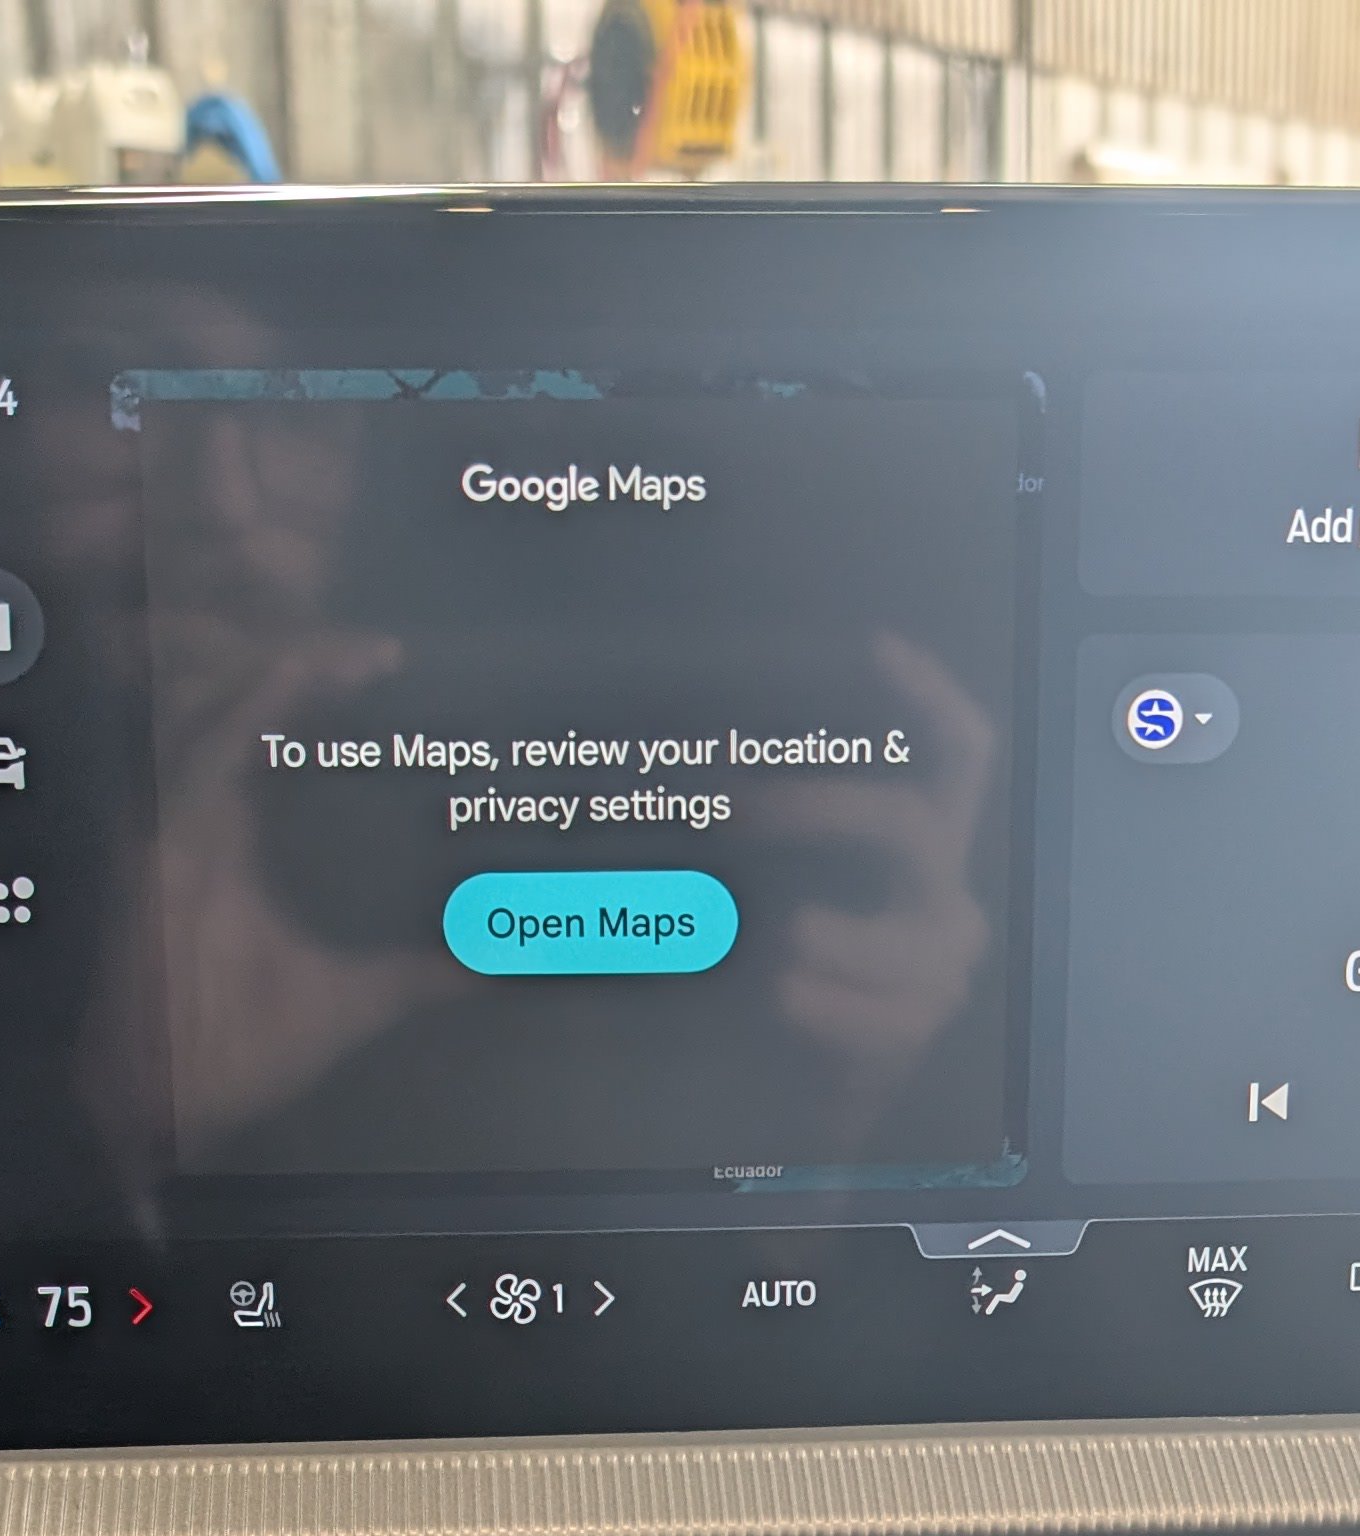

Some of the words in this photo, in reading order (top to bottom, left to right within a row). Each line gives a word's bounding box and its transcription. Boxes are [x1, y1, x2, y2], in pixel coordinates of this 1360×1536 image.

[461, 463, 600, 512] Google
[608, 464, 707, 511] Maps
[1286, 507, 1354, 544] Add
[260, 733, 307, 768] To
[317, 740, 382, 768] use
[393, 733, 499, 776] Maps,
[512, 729, 630, 767] review
[638, 738, 720, 774] your
[730, 728, 872, 765] location
[883, 729, 910, 764] &
[449, 786, 580, 831] privacy
[589, 785, 732, 830] settings
[487, 907, 585, 947] Open
[599, 906, 696, 946] Maps
[1187, 1245, 1248, 1273] MAX
[36, 1285, 92, 1328] 75
[552, 1283, 564, 1314] 1
[741, 1279, 817, 1308] AUTO
